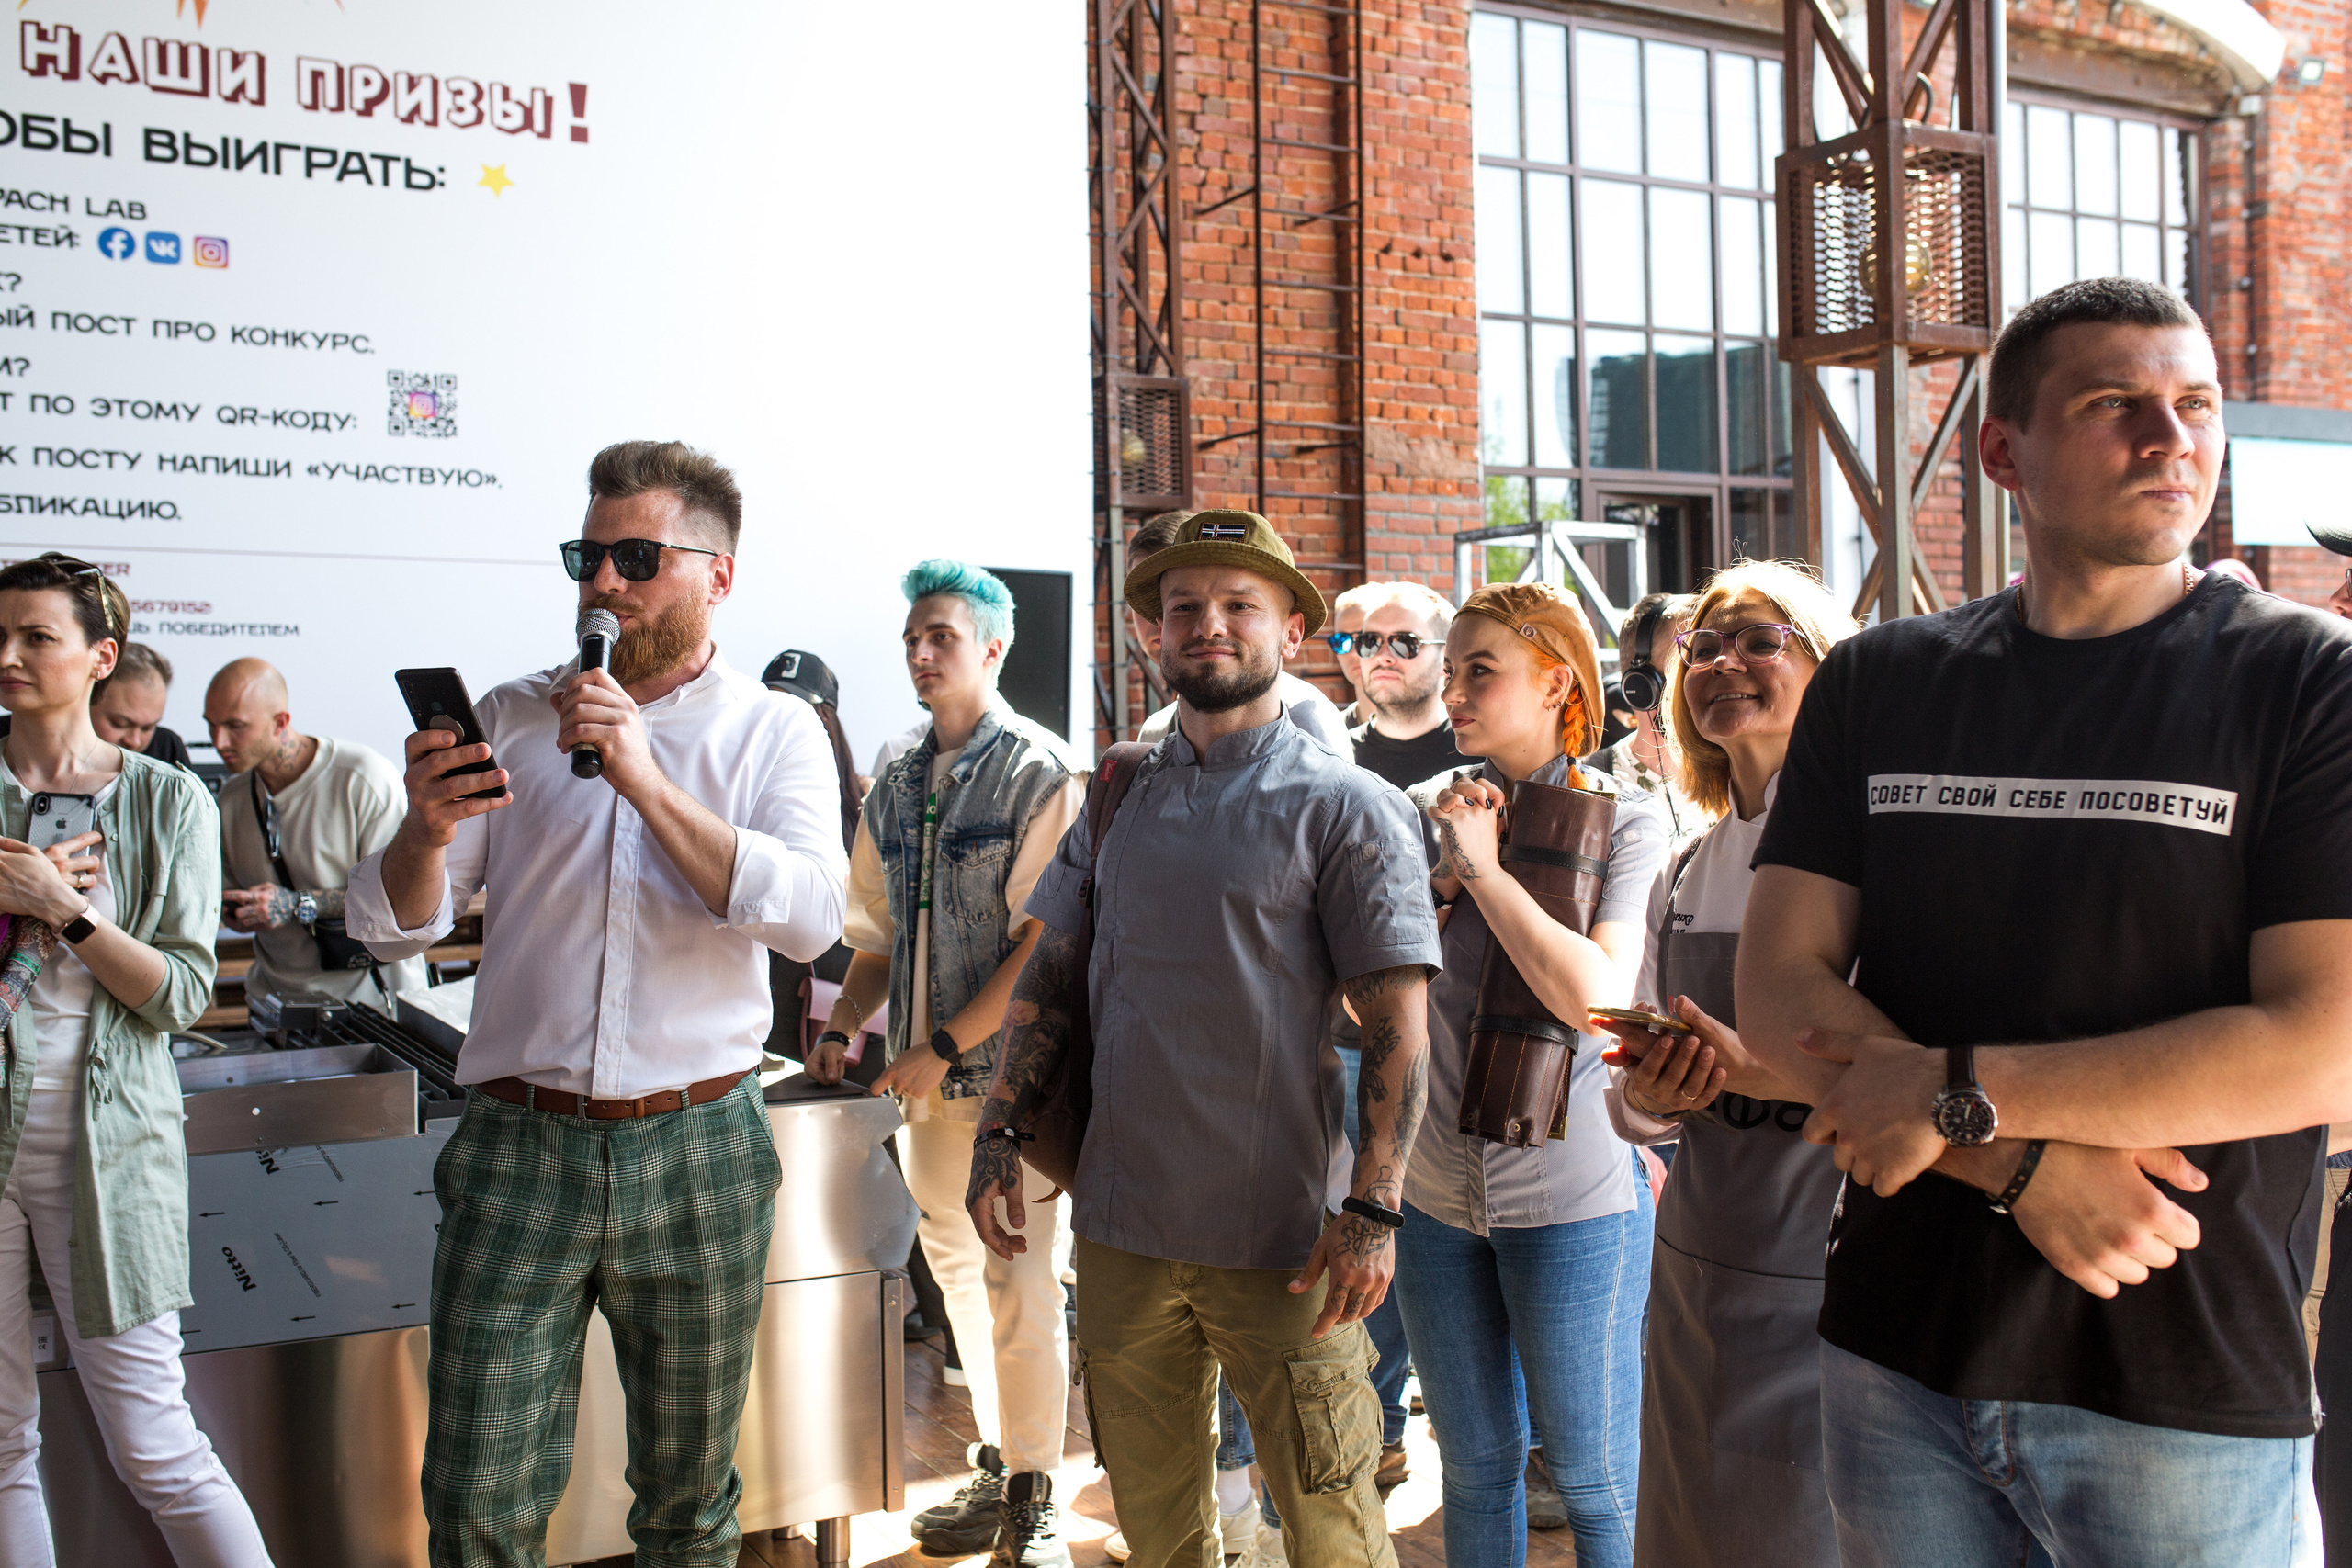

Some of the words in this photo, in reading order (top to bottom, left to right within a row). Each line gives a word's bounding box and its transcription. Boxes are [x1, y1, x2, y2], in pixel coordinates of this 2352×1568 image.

[20, 20, 266, 106] НАШИ
[297, 56, 589, 143] ПРИЗЫ!
[142, 126, 447, 190] ВЫИГРАТЬ:
[0, 187, 70, 213] ACH
[85, 197, 147, 220] LAB
[51, 310, 137, 335] ПОСТ
[153, 319, 216, 343] ПРО
[231, 325, 375, 354] КОНКУРС.
[30, 393, 74, 415] ПО
[90, 397, 201, 422] ЭТОМУ
[217, 405, 357, 433] QR-КОДУ:
[33, 446, 142, 470] ПОСТУ
[158, 453, 291, 478] НАПИШИ
[1871, 784, 1928, 806] СОВЕТ
[1937, 784, 1997, 807] СВОЙ
[2009, 789, 2068, 809] СЕБЕ
[2079, 790, 2229, 825] ПОСОВЕТУЙ
[221, 1246, 257, 1292] Nitto
